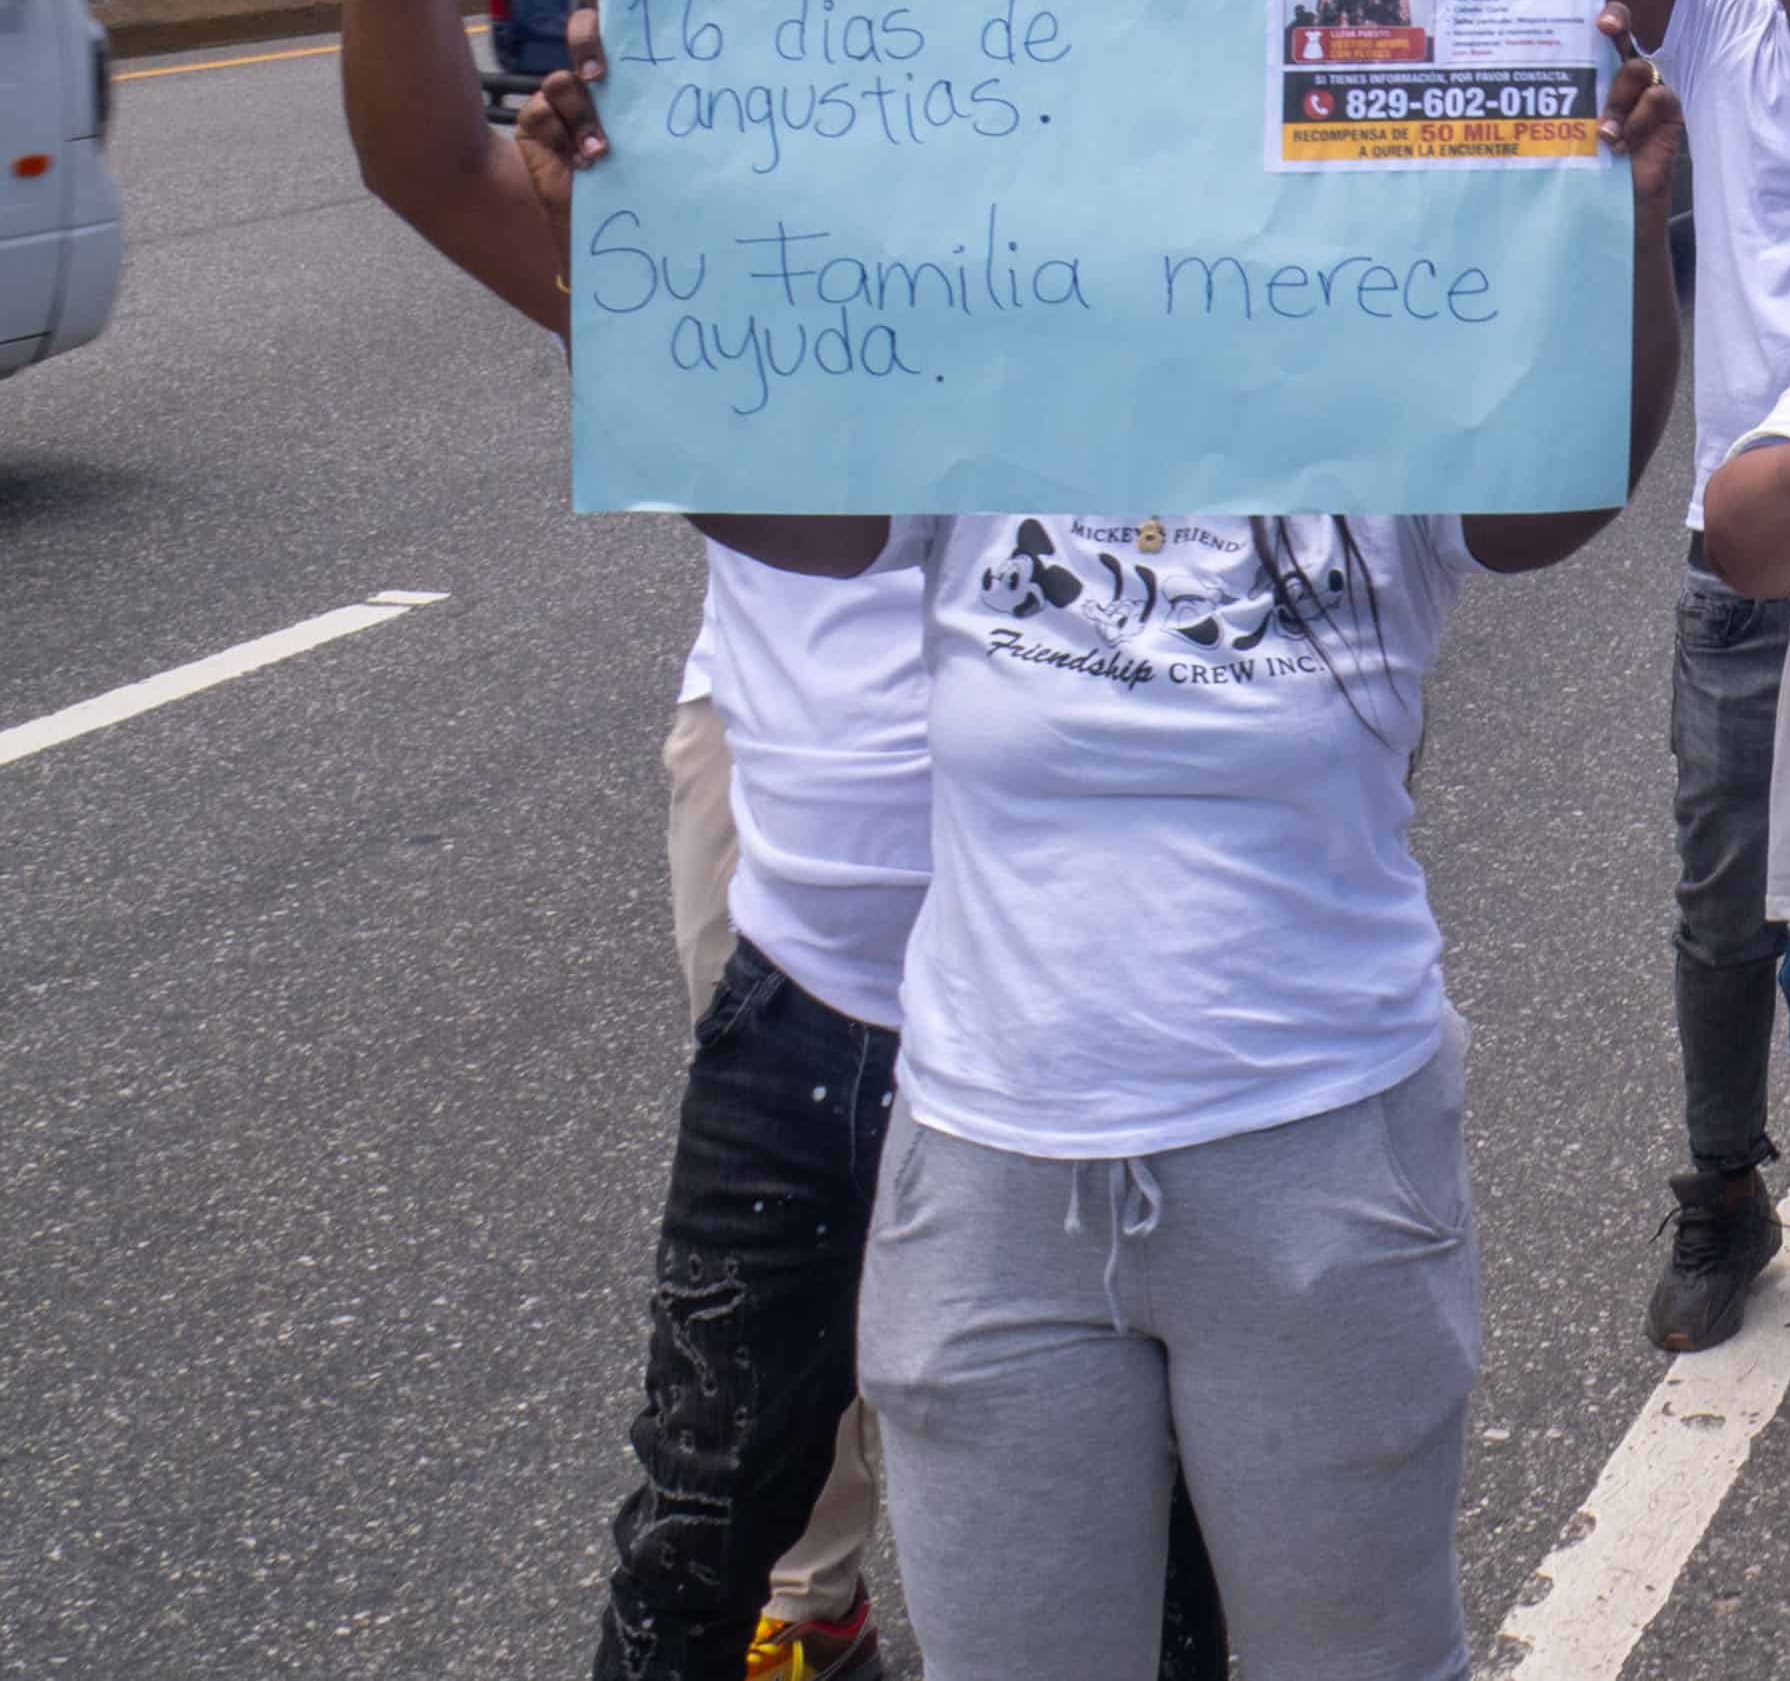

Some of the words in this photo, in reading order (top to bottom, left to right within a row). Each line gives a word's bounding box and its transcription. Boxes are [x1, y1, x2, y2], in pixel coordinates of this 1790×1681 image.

[1450, 72, 1473, 84] POR
[1476, 71, 1511, 83] FAVOR
[666, 72, 1051, 174] angustias.
[1345, 87, 1579, 120] 829-602-0167
[1293, 127, 1387, 142] RECOMPENSA
[1392, 128, 1409, 141] DE
[1419, 123, 1454, 142] 50
[1463, 123, 1505, 142] MIL
[1513, 122, 1587, 141] PESOS
[1358, 144, 1367, 157] A
[1372, 143, 1413, 158] QUIEN
[1417, 143, 1436, 157] LA
[1439, 142, 1521, 157] ENCUENTRE
[590, 210, 706, 313] Su
[1164, 255, 1499, 323] merece
[670, 305, 944, 417] ayuda.
[988, 628, 1156, 690] Friendship
[1168, 657, 1255, 685] CREW
[1266, 654, 1326, 678] INC.
